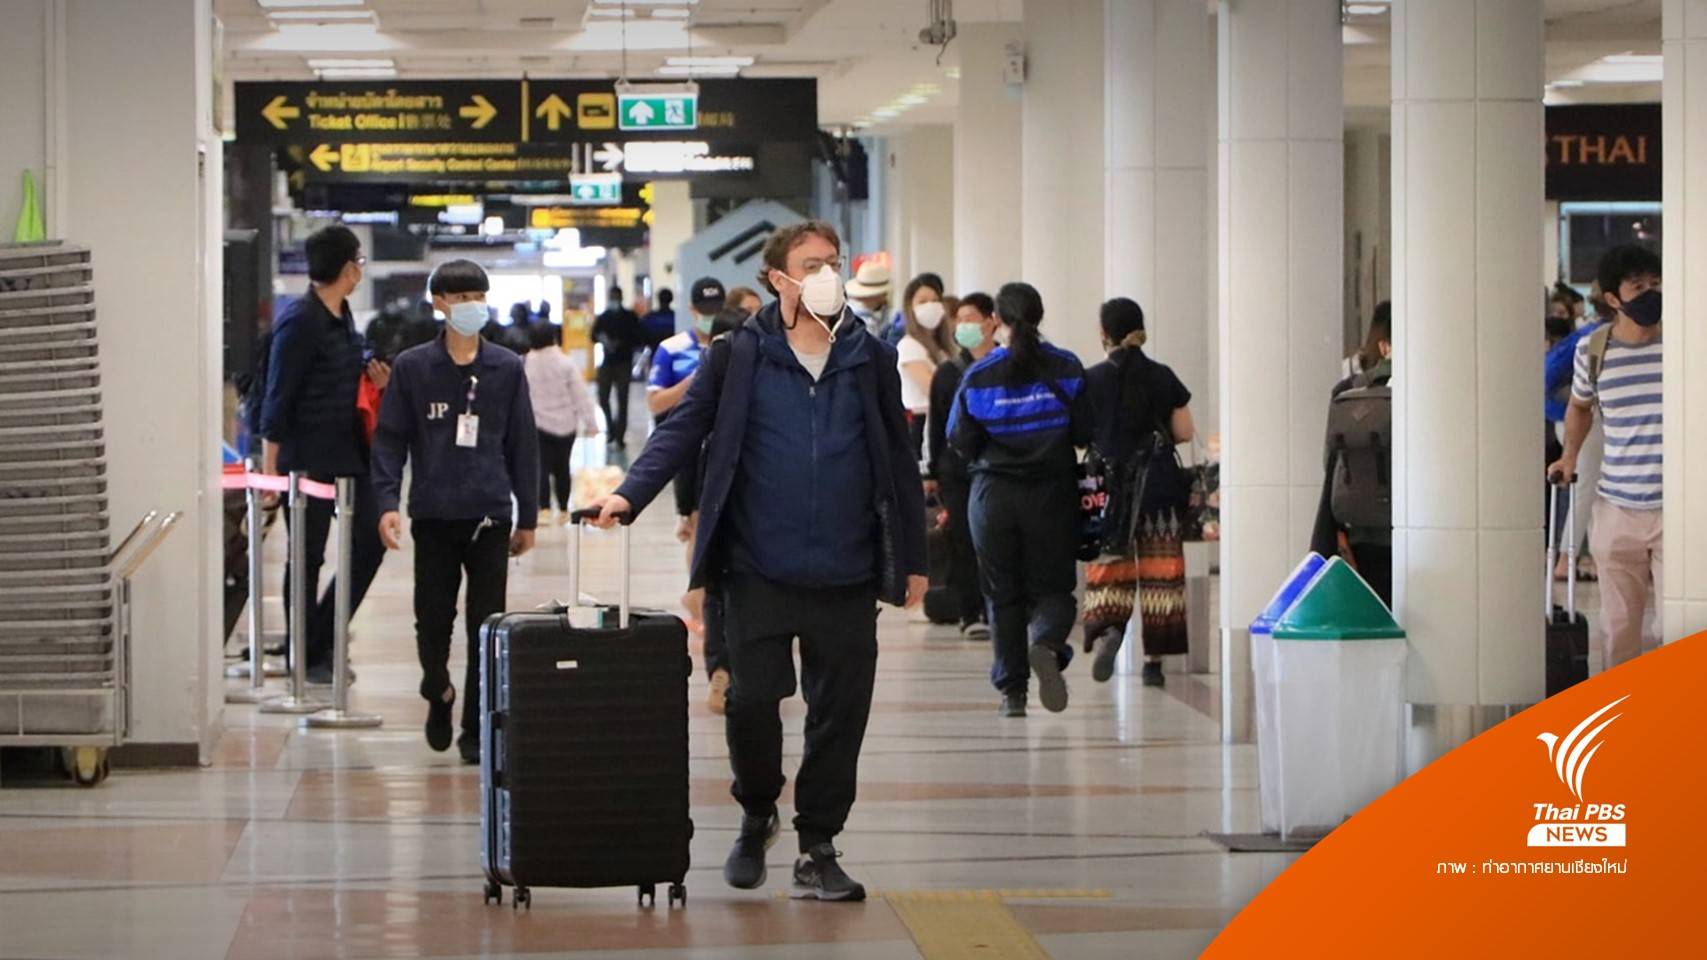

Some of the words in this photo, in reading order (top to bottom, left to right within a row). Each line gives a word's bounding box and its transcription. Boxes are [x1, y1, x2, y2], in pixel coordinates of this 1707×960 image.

[308, 114, 352, 130] Ticket
[354, 114, 397, 130] Office
[427, 402, 450, 420] JP
[1079, 491, 1105, 511] OVE
